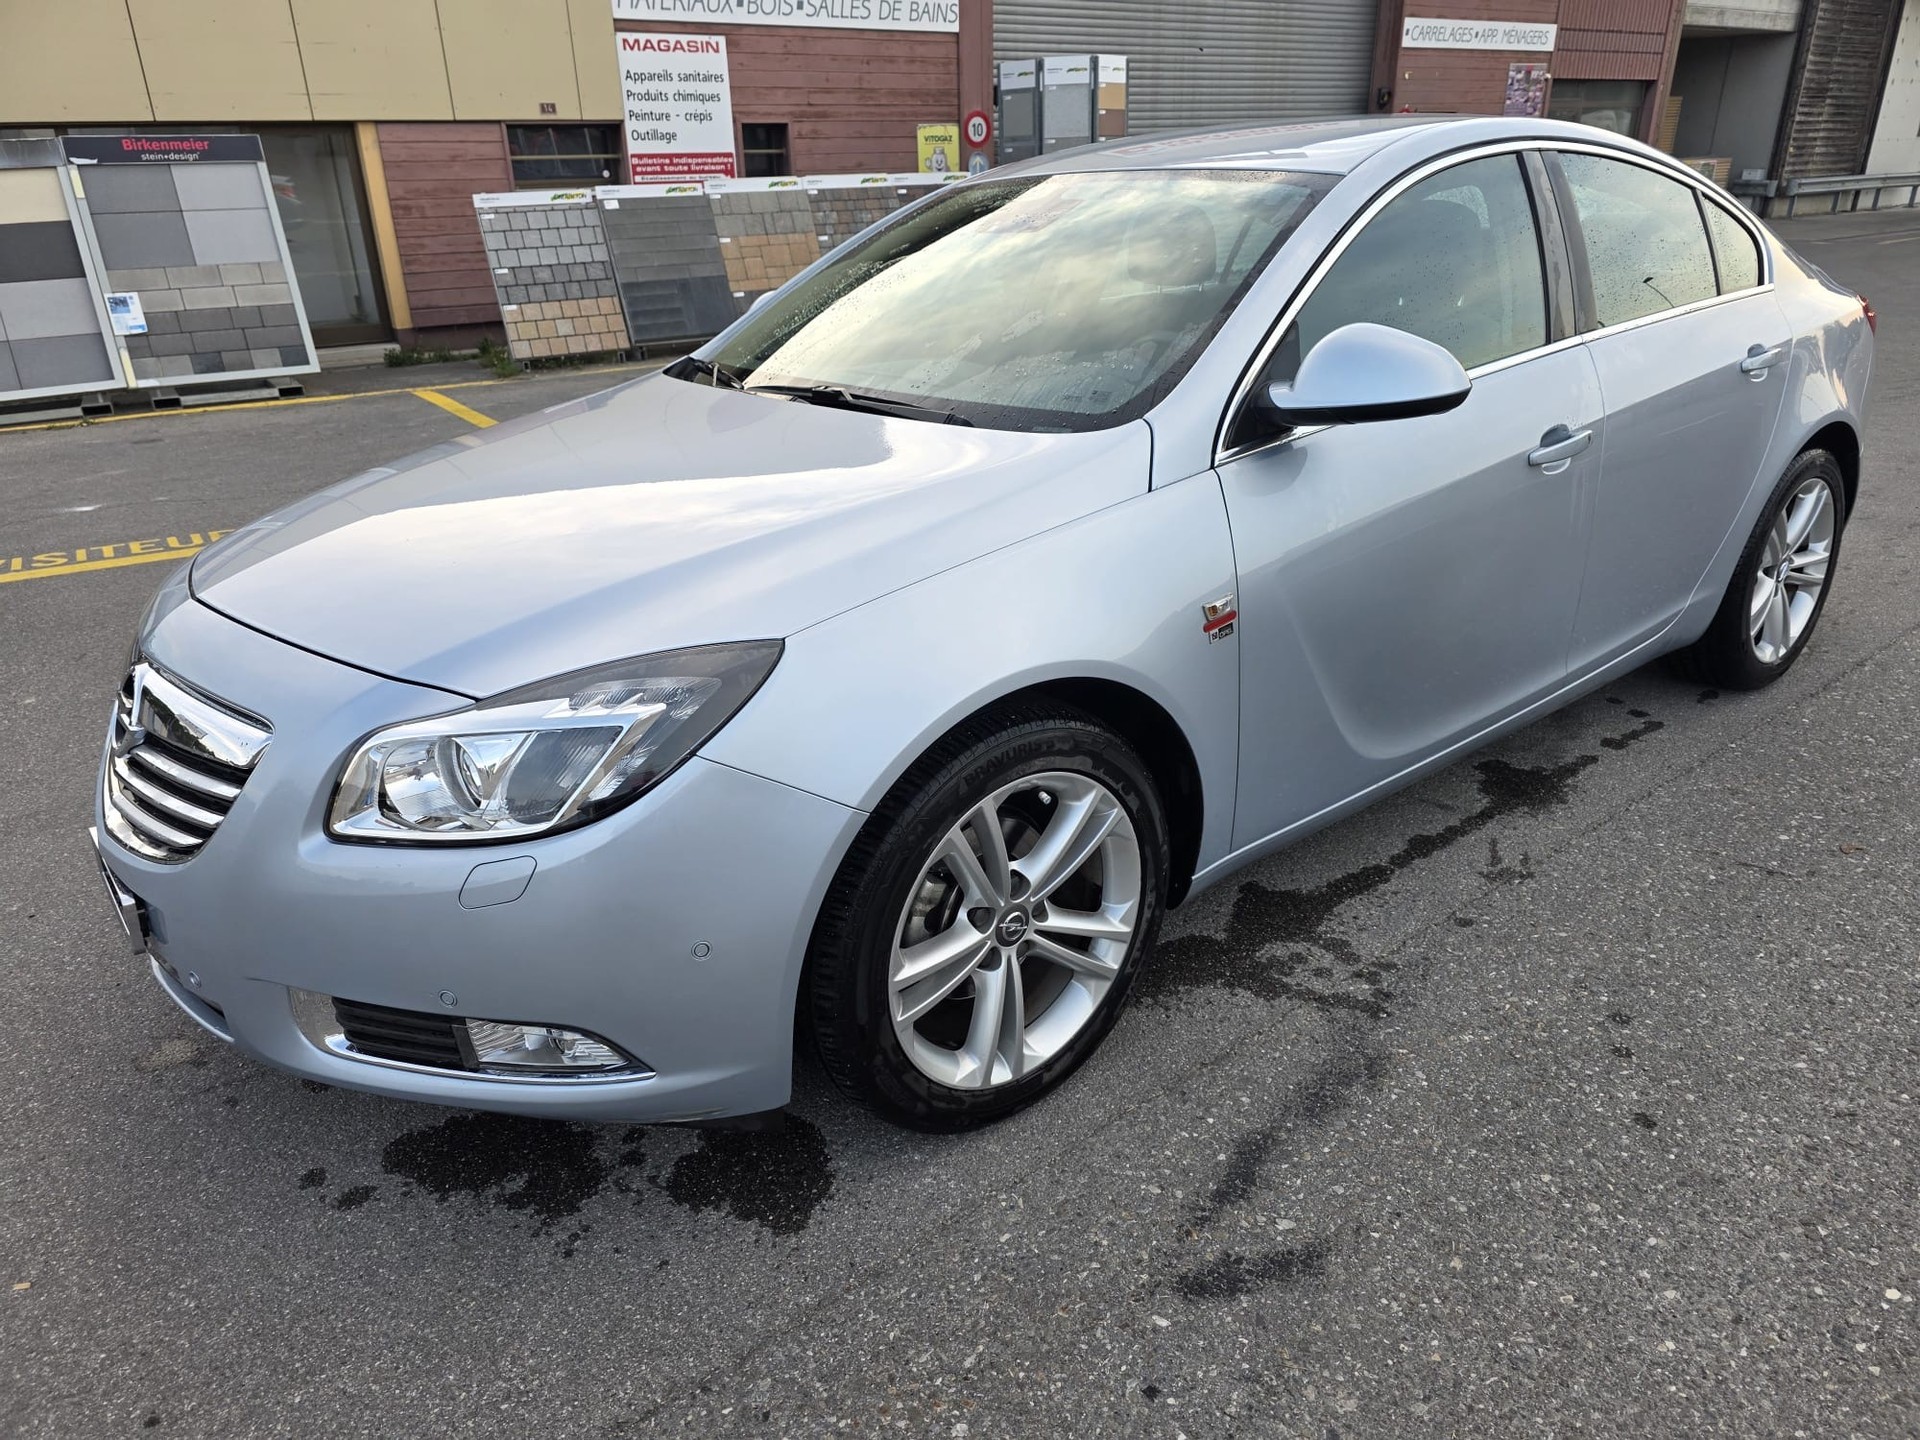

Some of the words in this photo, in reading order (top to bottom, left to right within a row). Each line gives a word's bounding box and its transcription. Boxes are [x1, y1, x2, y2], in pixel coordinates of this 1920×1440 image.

[747, 0, 794, 16] BOIS
[805, 0, 872, 20] SALLES
[878, 0, 902, 21] DE
[909, 1, 959, 24] BAINS
[1411, 25, 1474, 43] CARRELAGES
[1478, 28, 1499, 43] APP.
[1501, 26, 1550, 46] MÉNAGERS
[622, 38, 721, 54] MAGASIN
[625, 69, 674, 85] Appareils
[677, 70, 725, 83] sanitaires
[626, 89, 669, 102] Produits
[672, 89, 721, 105] chimiques
[628, 109, 672, 121] Peinture
[684, 109, 713, 125] crépis
[631, 129, 678, 144] Outillage
[972, 123, 984, 137] 10
[121, 137, 209, 151] Birkenmeier
[924, 134, 953, 143] VITOGAZ
[631, 156, 670, 165] Bulletins
[672, 156, 733, 164] indispensables
[664, 164, 689, 172] toute
[691, 163, 726, 171] livraison
[0, 528, 236, 571] ISITEU
